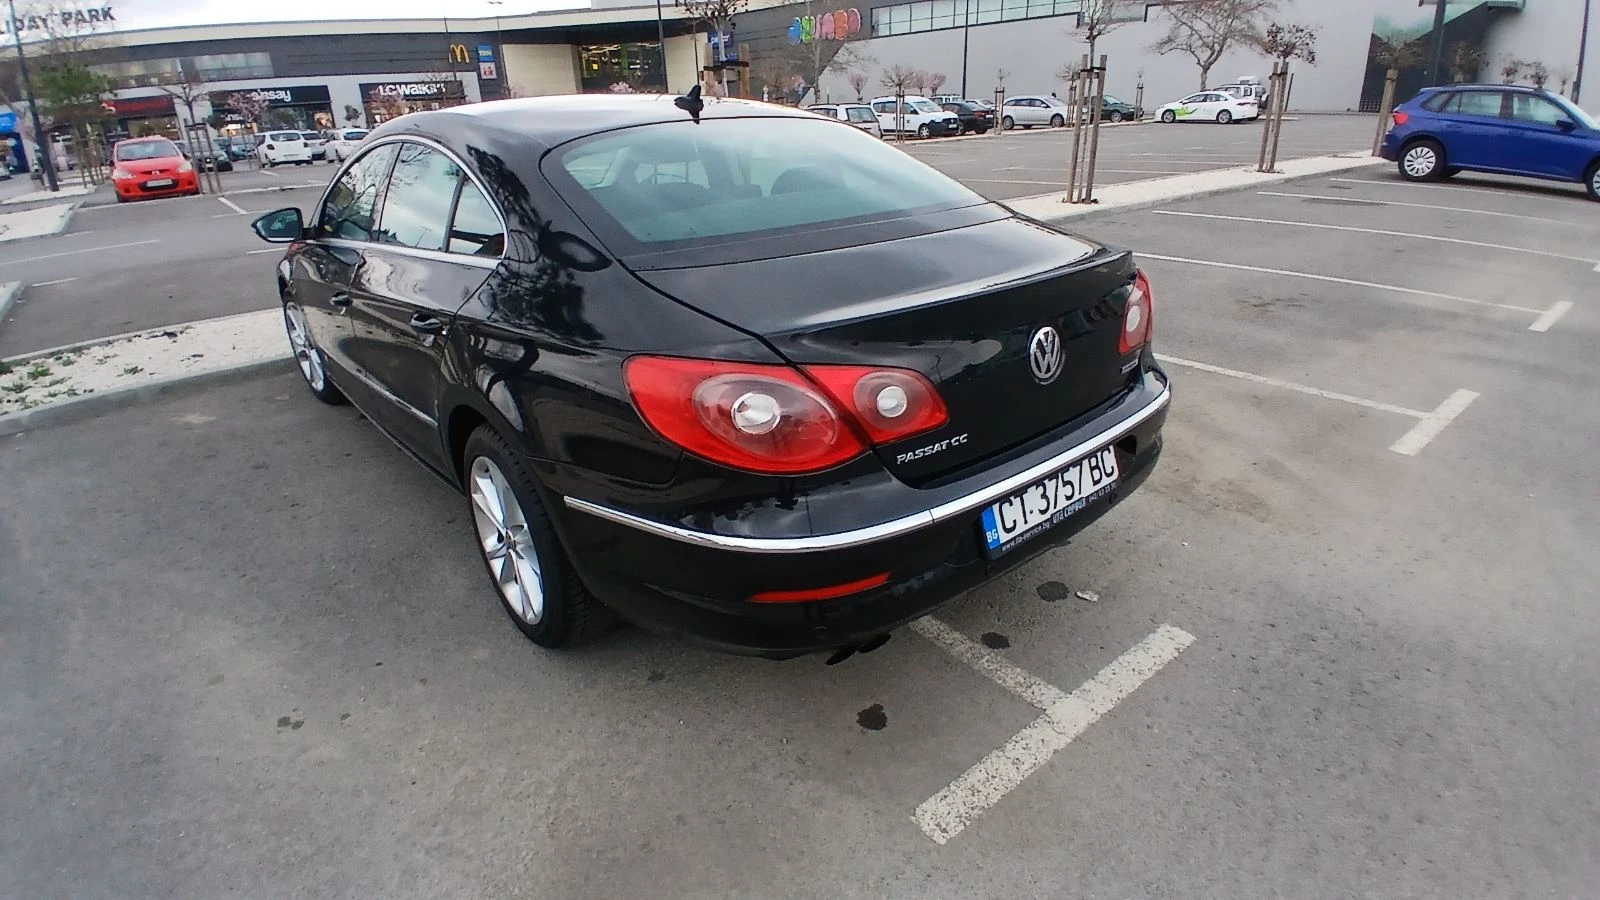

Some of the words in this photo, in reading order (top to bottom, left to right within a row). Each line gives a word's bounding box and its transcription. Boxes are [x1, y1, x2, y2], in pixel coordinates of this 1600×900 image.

[60, 7, 116, 27] PARK
[896, 440, 949, 465] PASSAT
[951, 433, 968, 446] CC
[986, 528, 998, 543] BG
